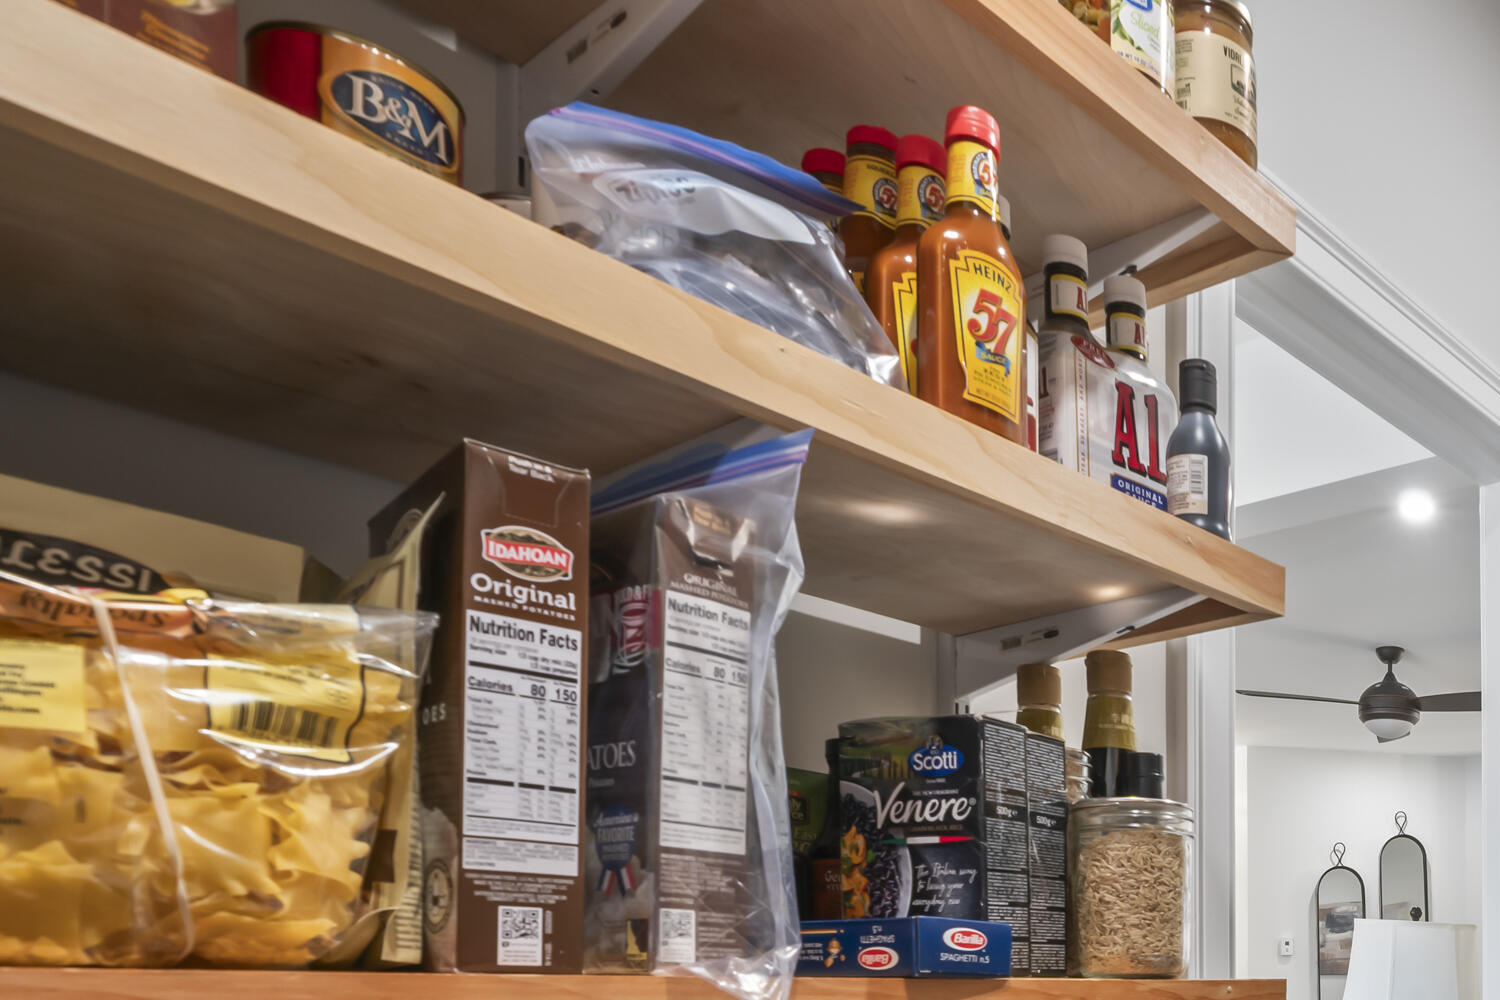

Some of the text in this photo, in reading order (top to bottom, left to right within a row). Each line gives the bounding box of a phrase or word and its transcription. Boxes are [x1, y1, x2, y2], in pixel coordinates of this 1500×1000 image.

[345, 73, 449, 164] B&M
[972, 262, 1013, 293] HEINZ
[967, 288, 1017, 356] 57
[1117, 479, 1164, 505] ORIGINAL
[0, 538, 152, 592] LESSI
[488, 540, 567, 568] IDAHOAN
[471, 572, 577, 611] Original
[667, 598, 749, 631] Nutrition Facts
[469, 615, 578, 652] Nutrition Facts
[468, 676, 577, 702] Calories 80 150
[588, 739, 636, 770] ATOES
[912, 750, 958, 772] Scotti
[873, 781, 972, 829] Venere
[953, 932, 983, 945] Barilla
[939, 952, 978, 964] SPAGHETTI
